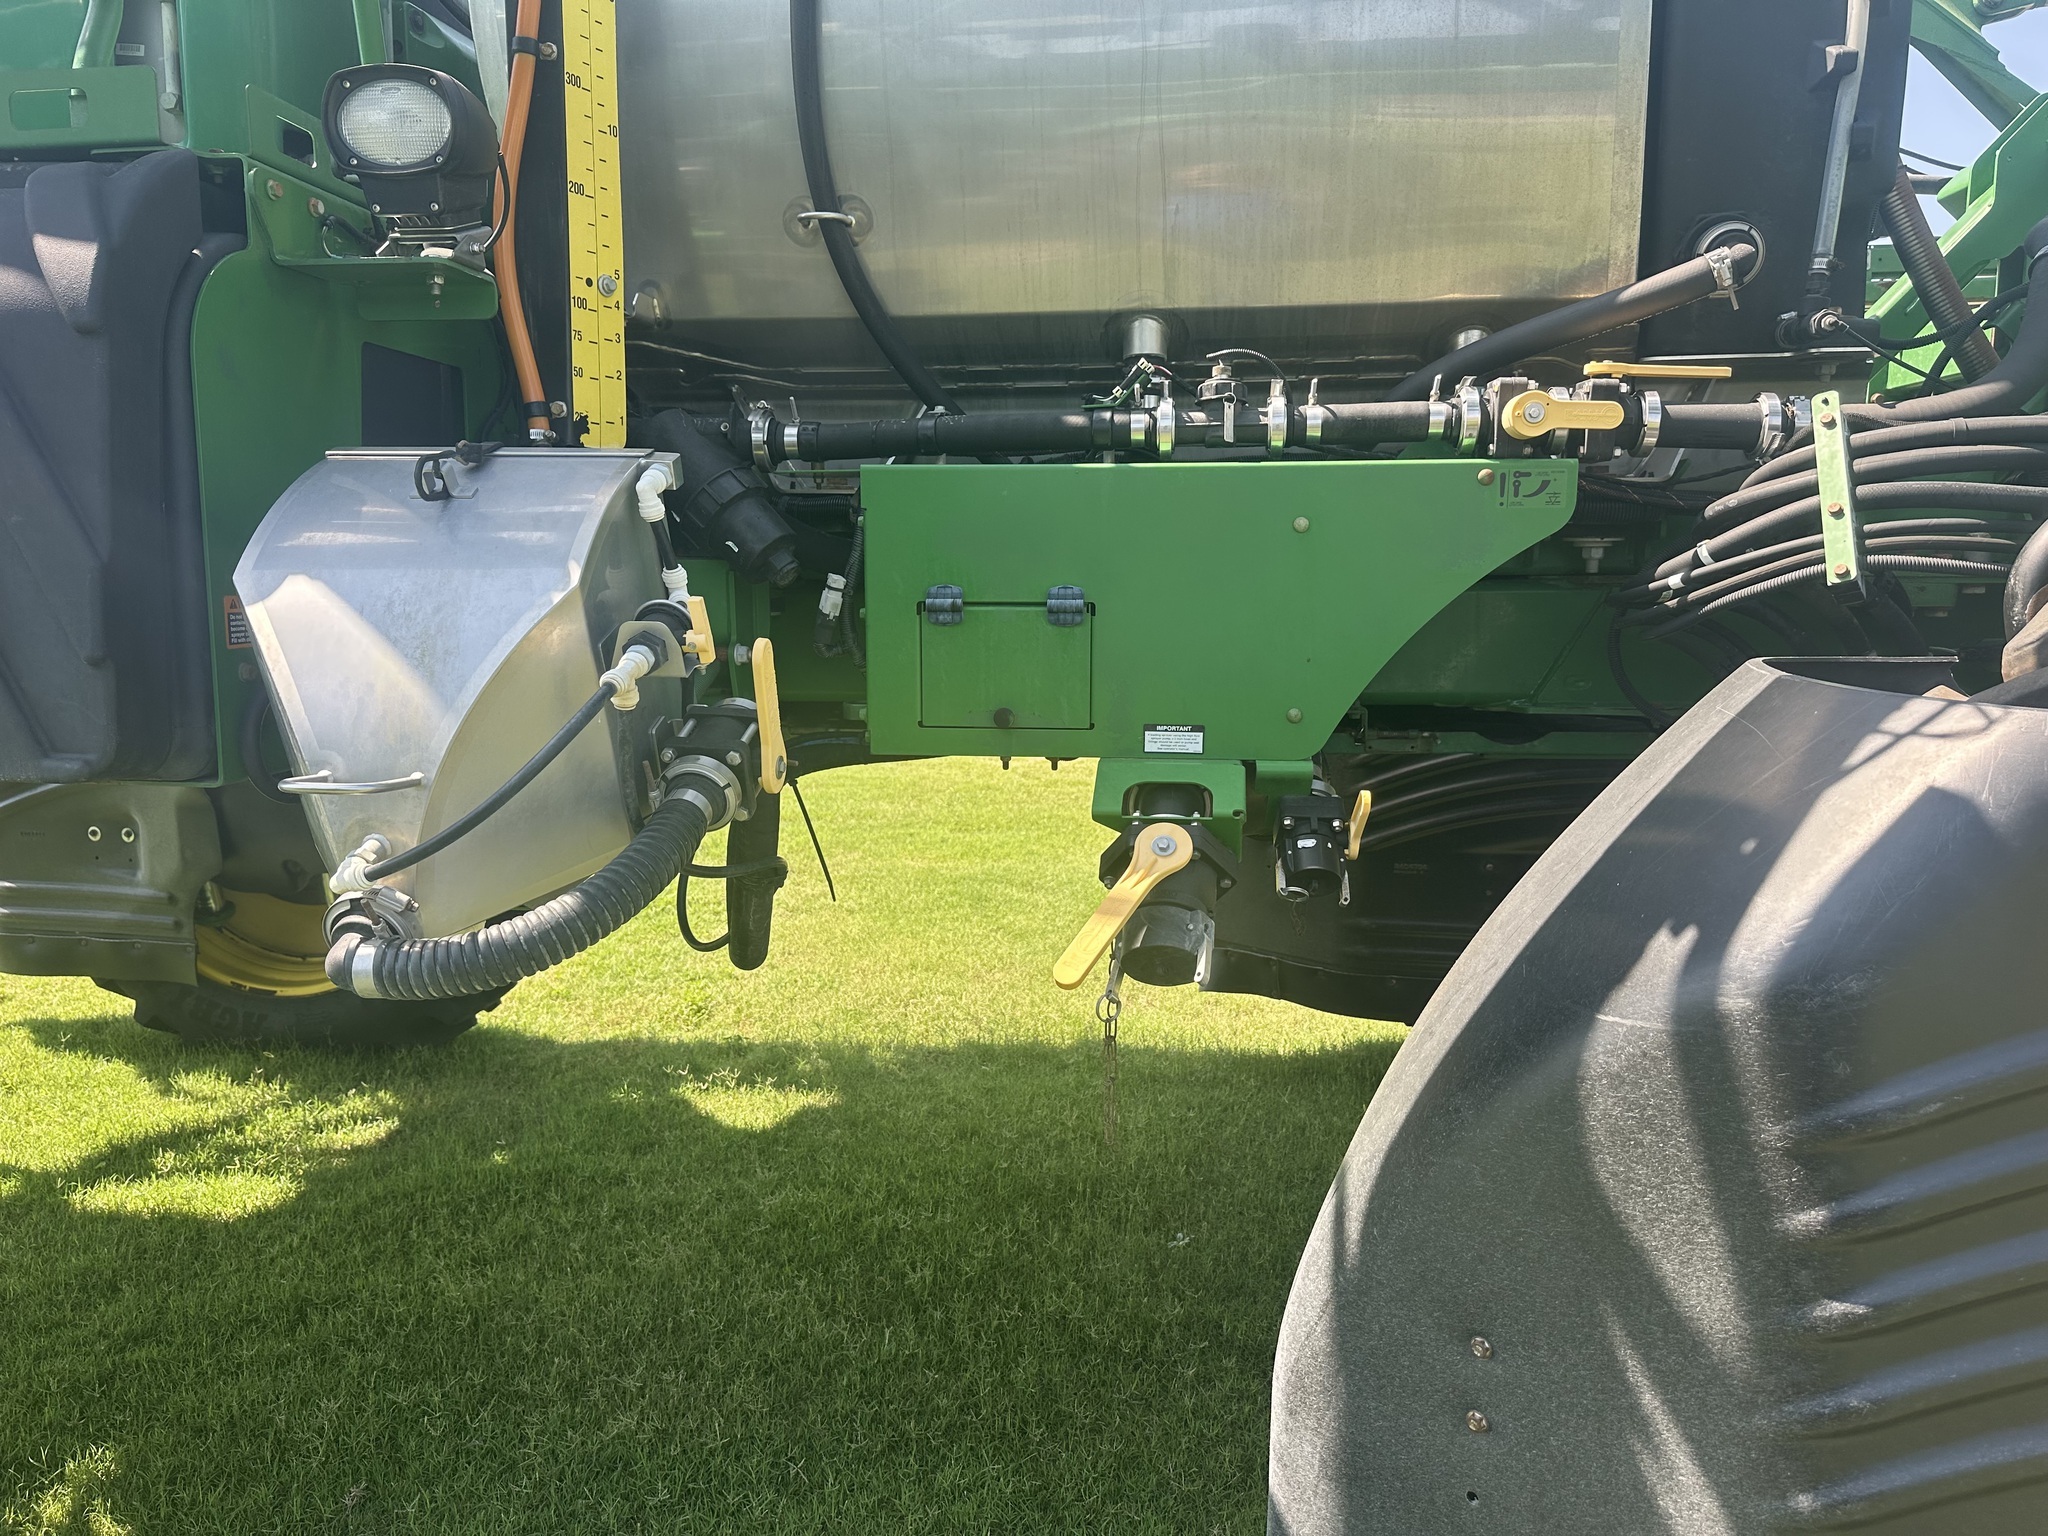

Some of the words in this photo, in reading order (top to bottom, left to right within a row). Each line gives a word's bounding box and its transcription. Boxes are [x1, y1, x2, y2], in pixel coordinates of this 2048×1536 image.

[565, 71, 581, 89] 300
[607, 124, 618, 138] 10
[568, 180, 585, 196] 200
[614, 269, 620, 280] 5
[571, 295, 587, 310] 100
[614, 300, 620, 311] 4
[572, 329, 583, 341] 75
[614, 333, 621, 344] 3
[573, 366, 583, 378] 50
[616, 369, 622, 381] 2
[619, 416, 624, 426] 1
